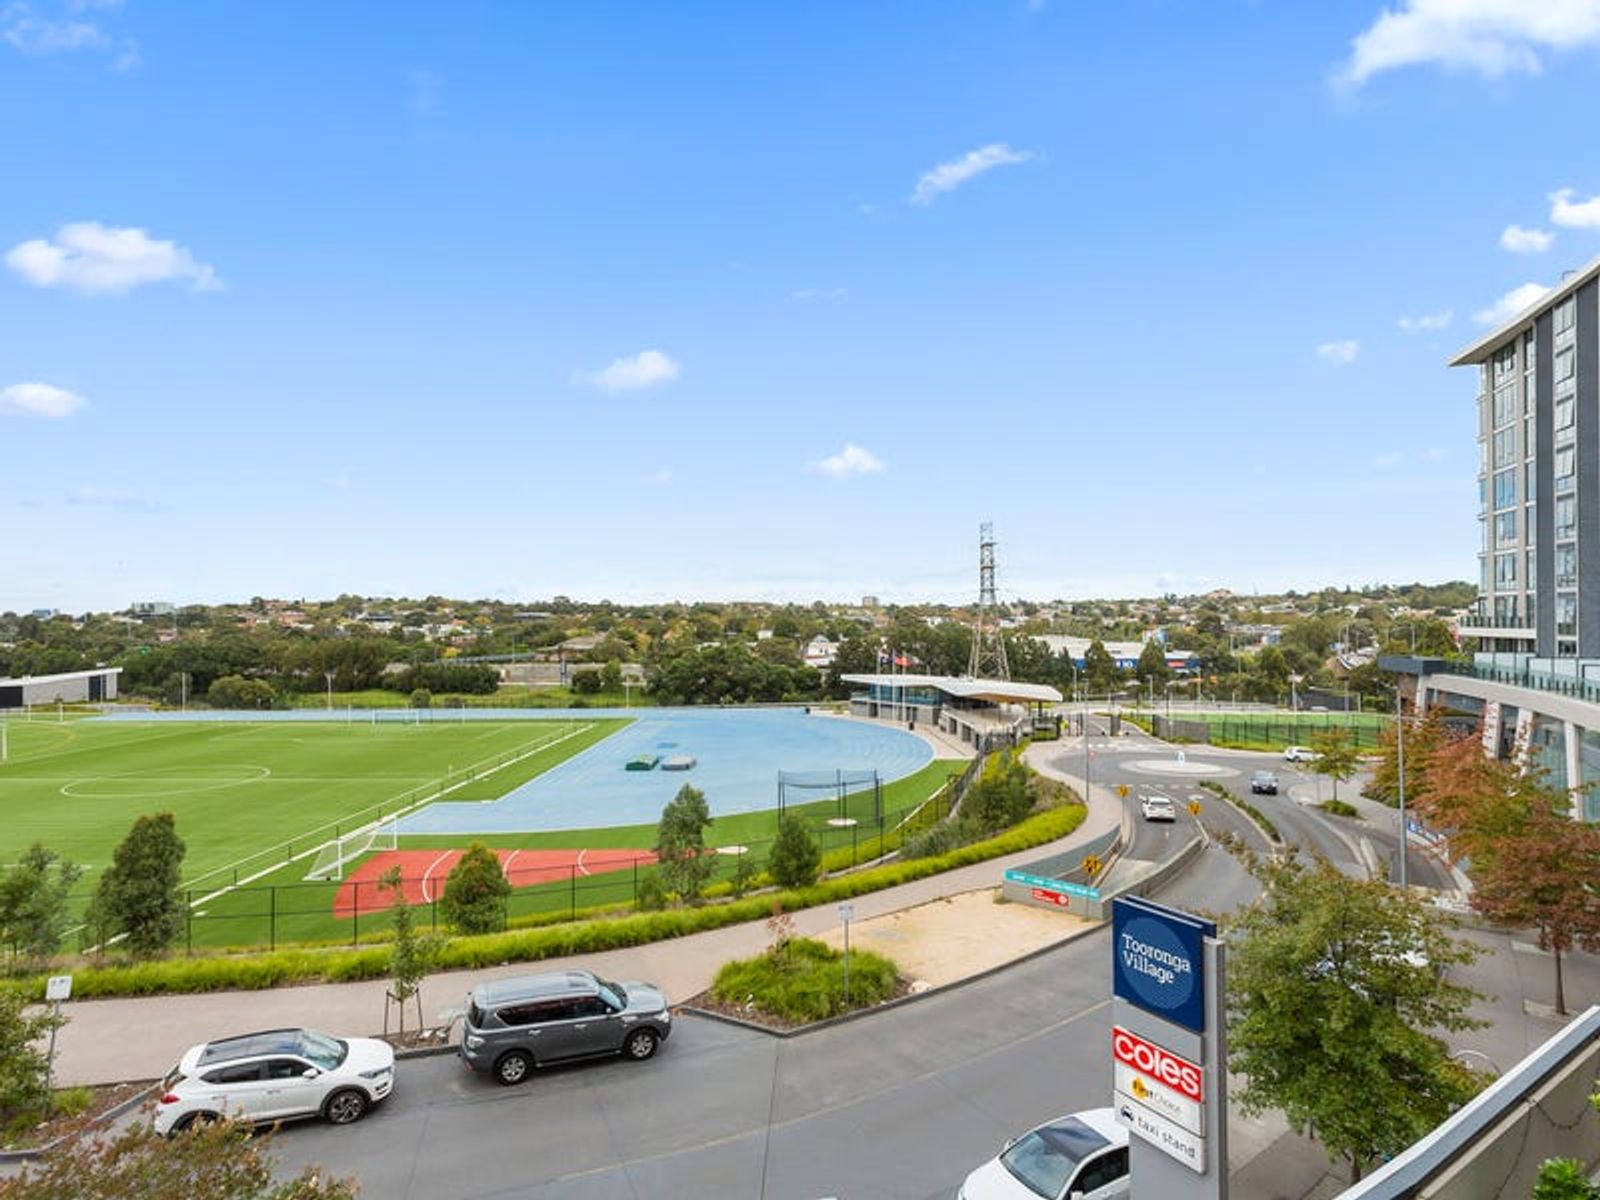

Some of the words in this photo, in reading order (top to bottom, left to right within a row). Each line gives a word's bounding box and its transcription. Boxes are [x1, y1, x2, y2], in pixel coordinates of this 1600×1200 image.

[1122, 933, 1191, 974] Tooronga
[1123, 950, 1174, 984] Village
[1115, 1034, 1199, 1095] coles
[1137, 1115, 1160, 1138] taxi
[1162, 1131, 1196, 1158] stand
